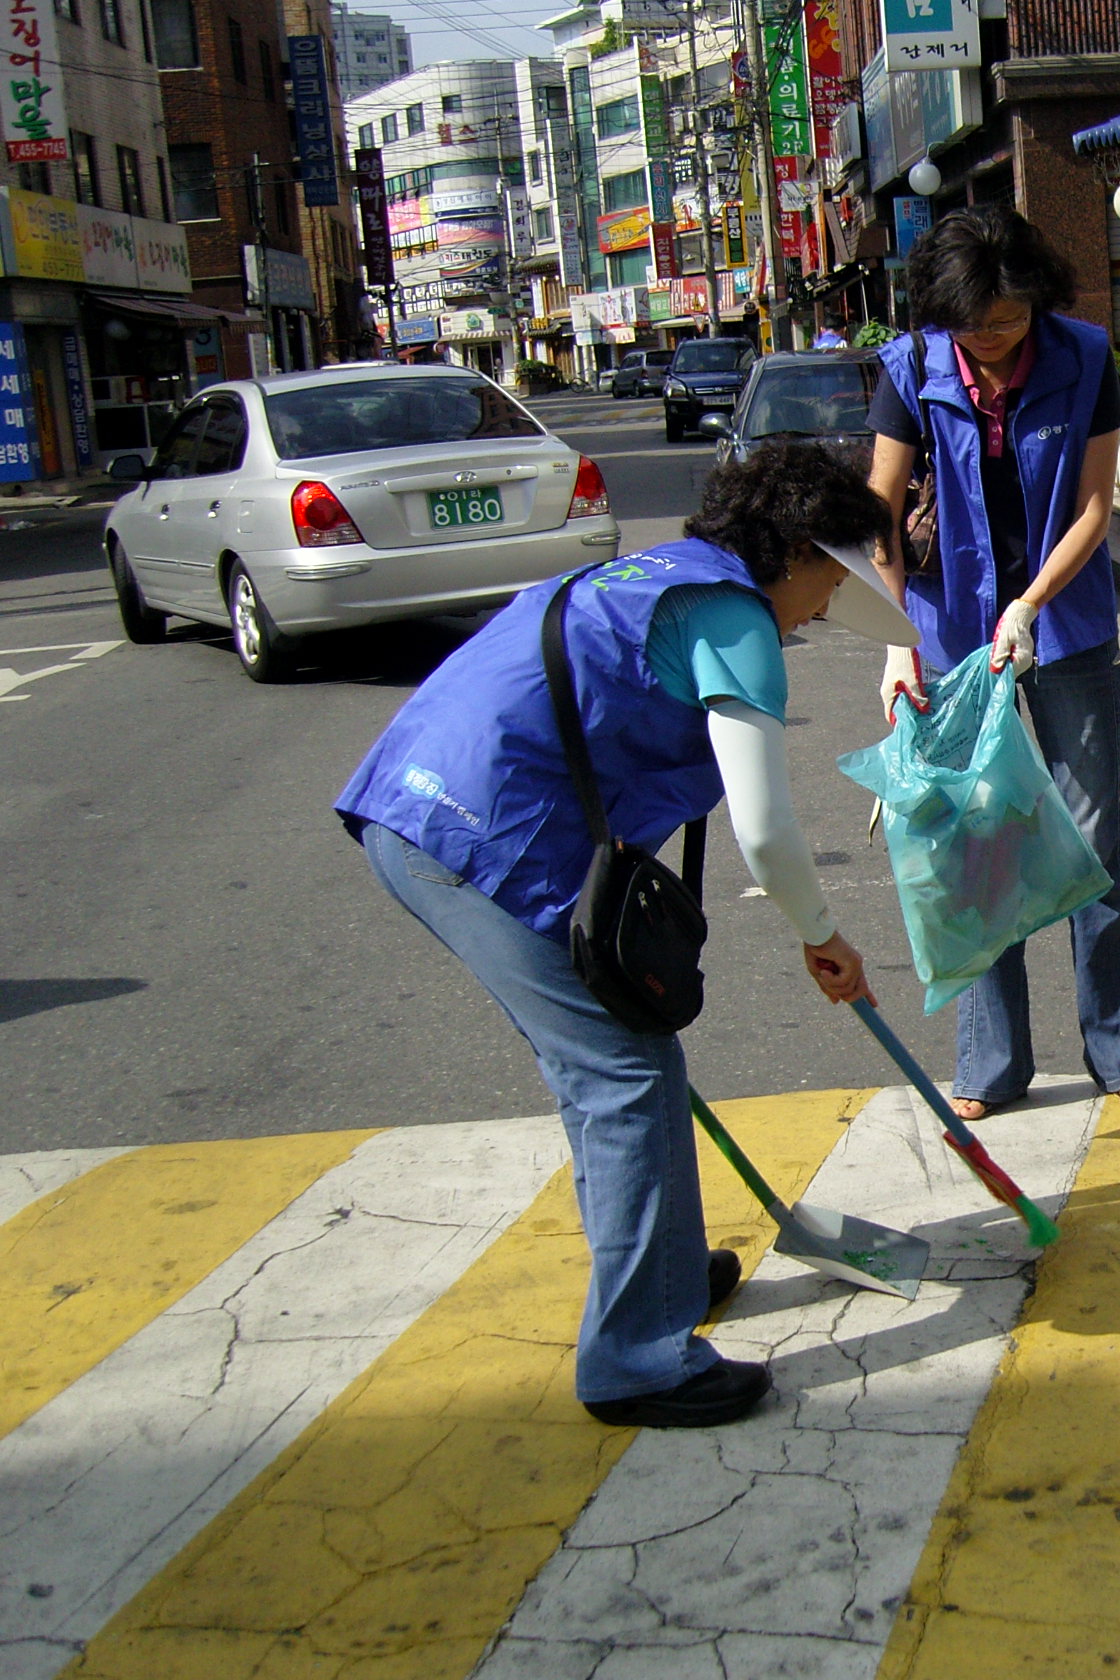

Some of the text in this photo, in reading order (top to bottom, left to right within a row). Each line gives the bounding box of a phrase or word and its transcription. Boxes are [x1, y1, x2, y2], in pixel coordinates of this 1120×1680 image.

[901, 43, 968, 59] 란제리
[5, 408, 25, 428] 매
[434, 499, 500, 526] 8180
